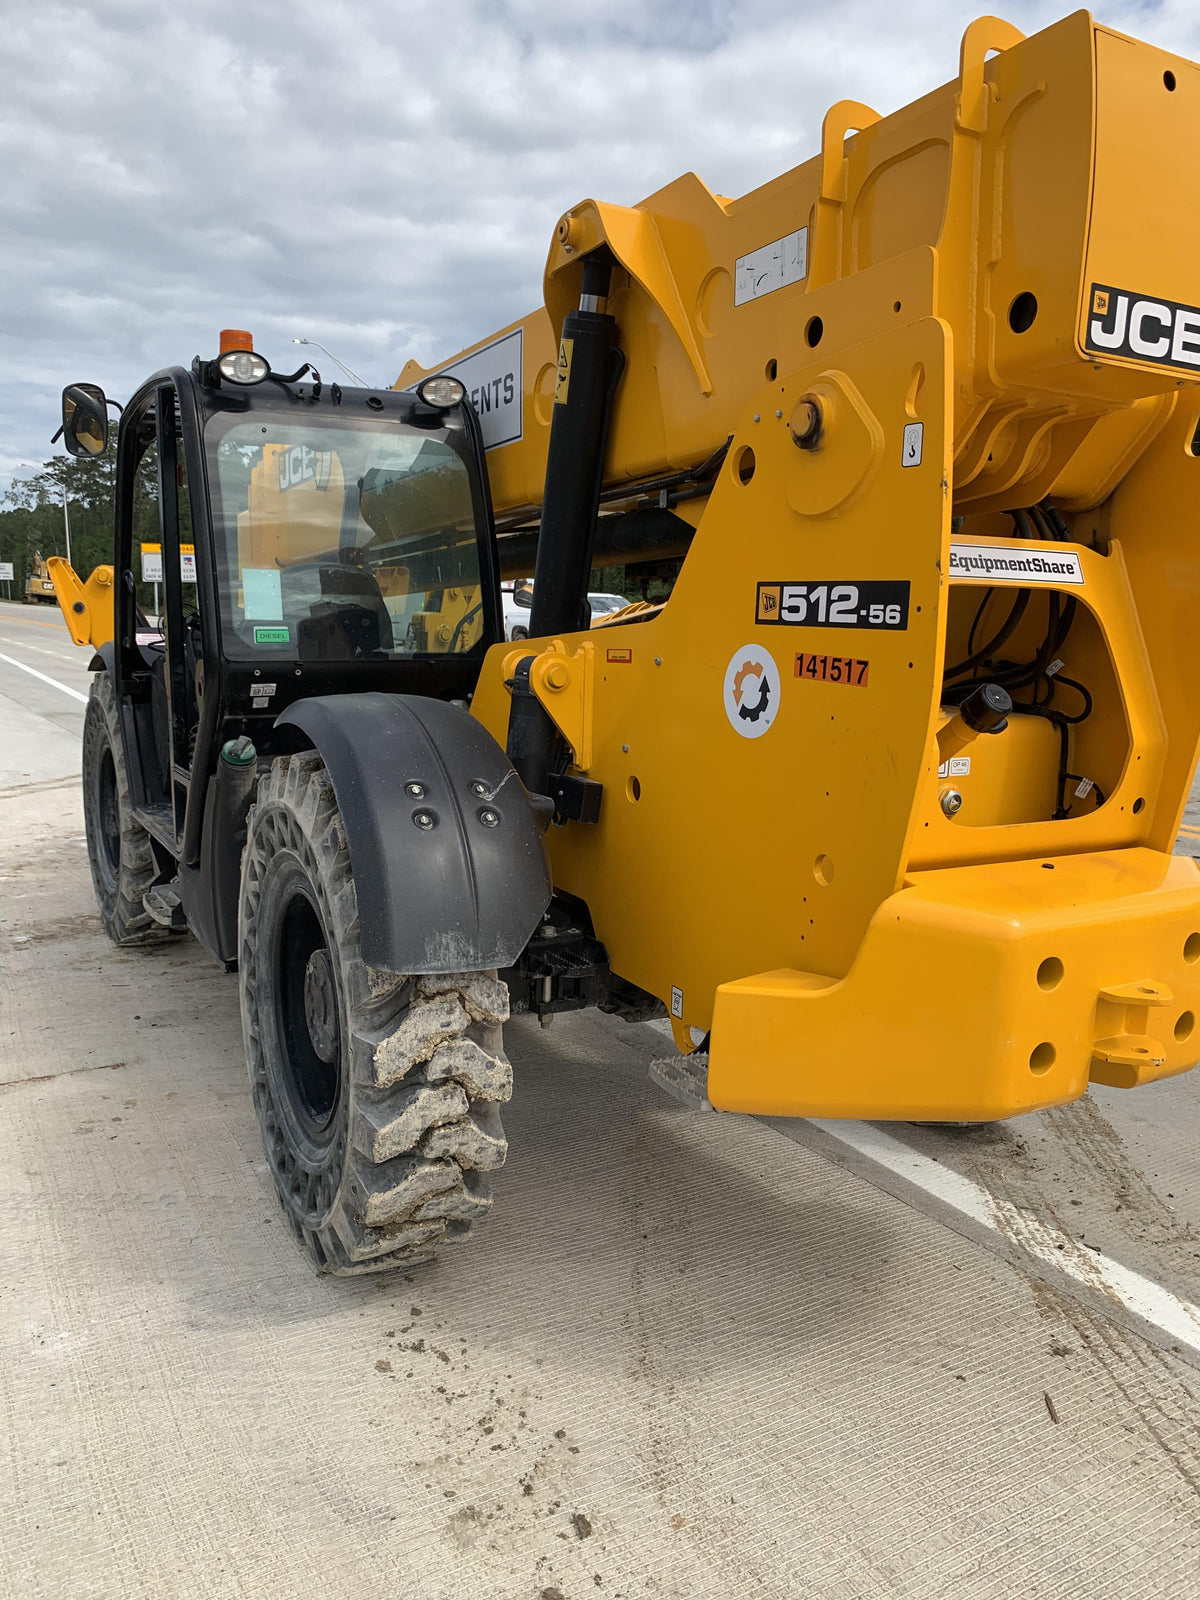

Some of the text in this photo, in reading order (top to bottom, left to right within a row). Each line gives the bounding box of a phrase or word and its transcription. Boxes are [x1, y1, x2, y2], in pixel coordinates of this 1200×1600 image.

[467, 372, 514, 416] ENTS
[949, 552, 1075, 575] EquipmentShare
[762, 593, 777, 613] JCB
[781, 585, 901, 625] 512-56
[796, 653, 869, 685] 141517
